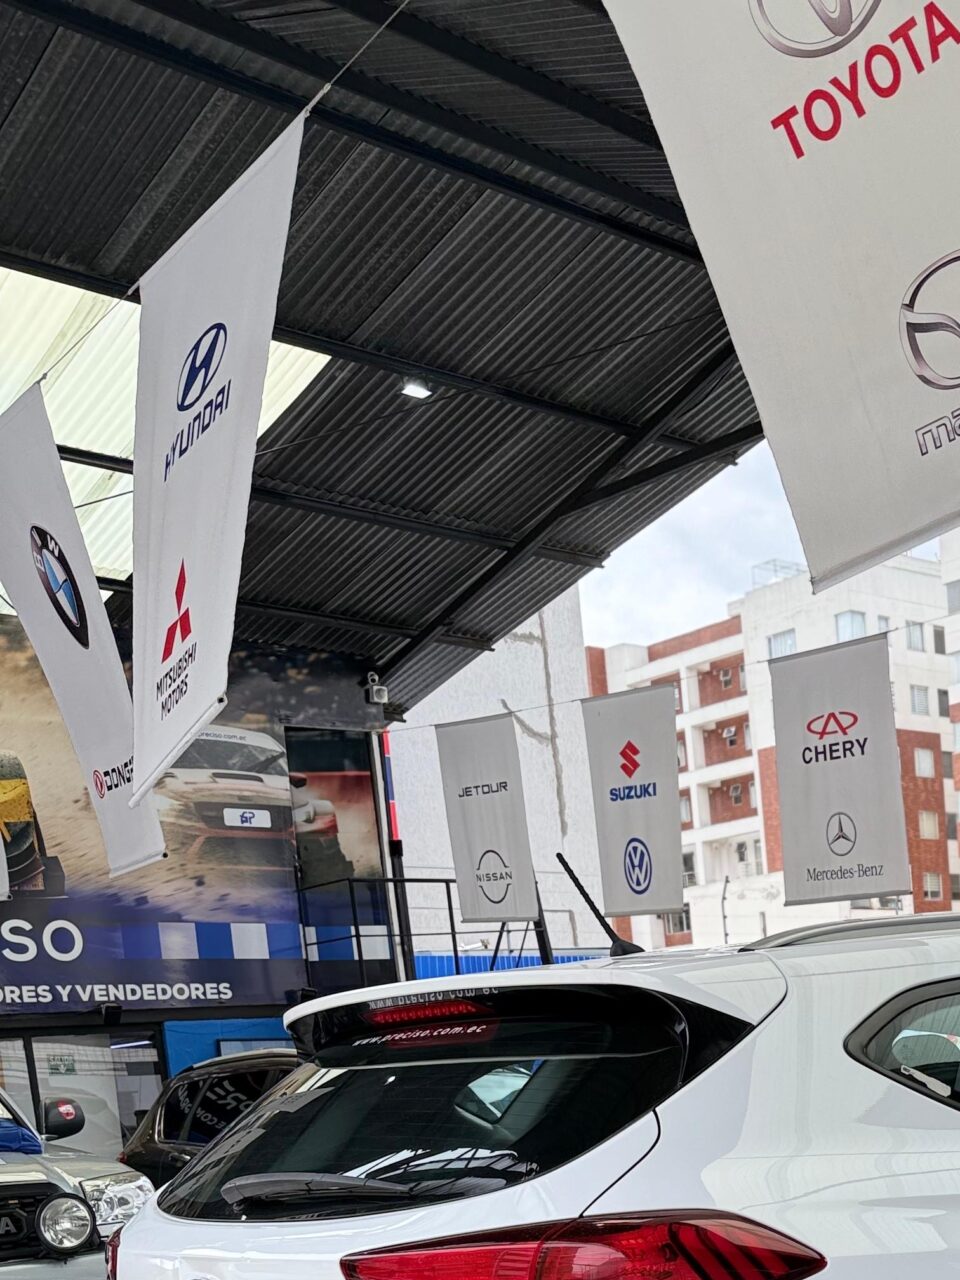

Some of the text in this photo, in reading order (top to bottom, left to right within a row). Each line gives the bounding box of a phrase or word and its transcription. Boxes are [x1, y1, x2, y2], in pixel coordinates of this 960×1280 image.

[163, 378, 232, 482] HYUNDAI
[156, 642, 197, 701] MITSUBISHI
[161, 673, 188, 721] MOTORS
[802, 737, 868, 764] CHERY
[458, 781, 508, 798] JETOUR
[609, 782, 657, 801] SUZUKI
[475, 871, 512, 882] NISSAN
[806, 863, 884, 882] Mercedes-Benz
[0, 919, 83, 962] SO
[0, 982, 232, 1003] RES Y VENDEDORES
